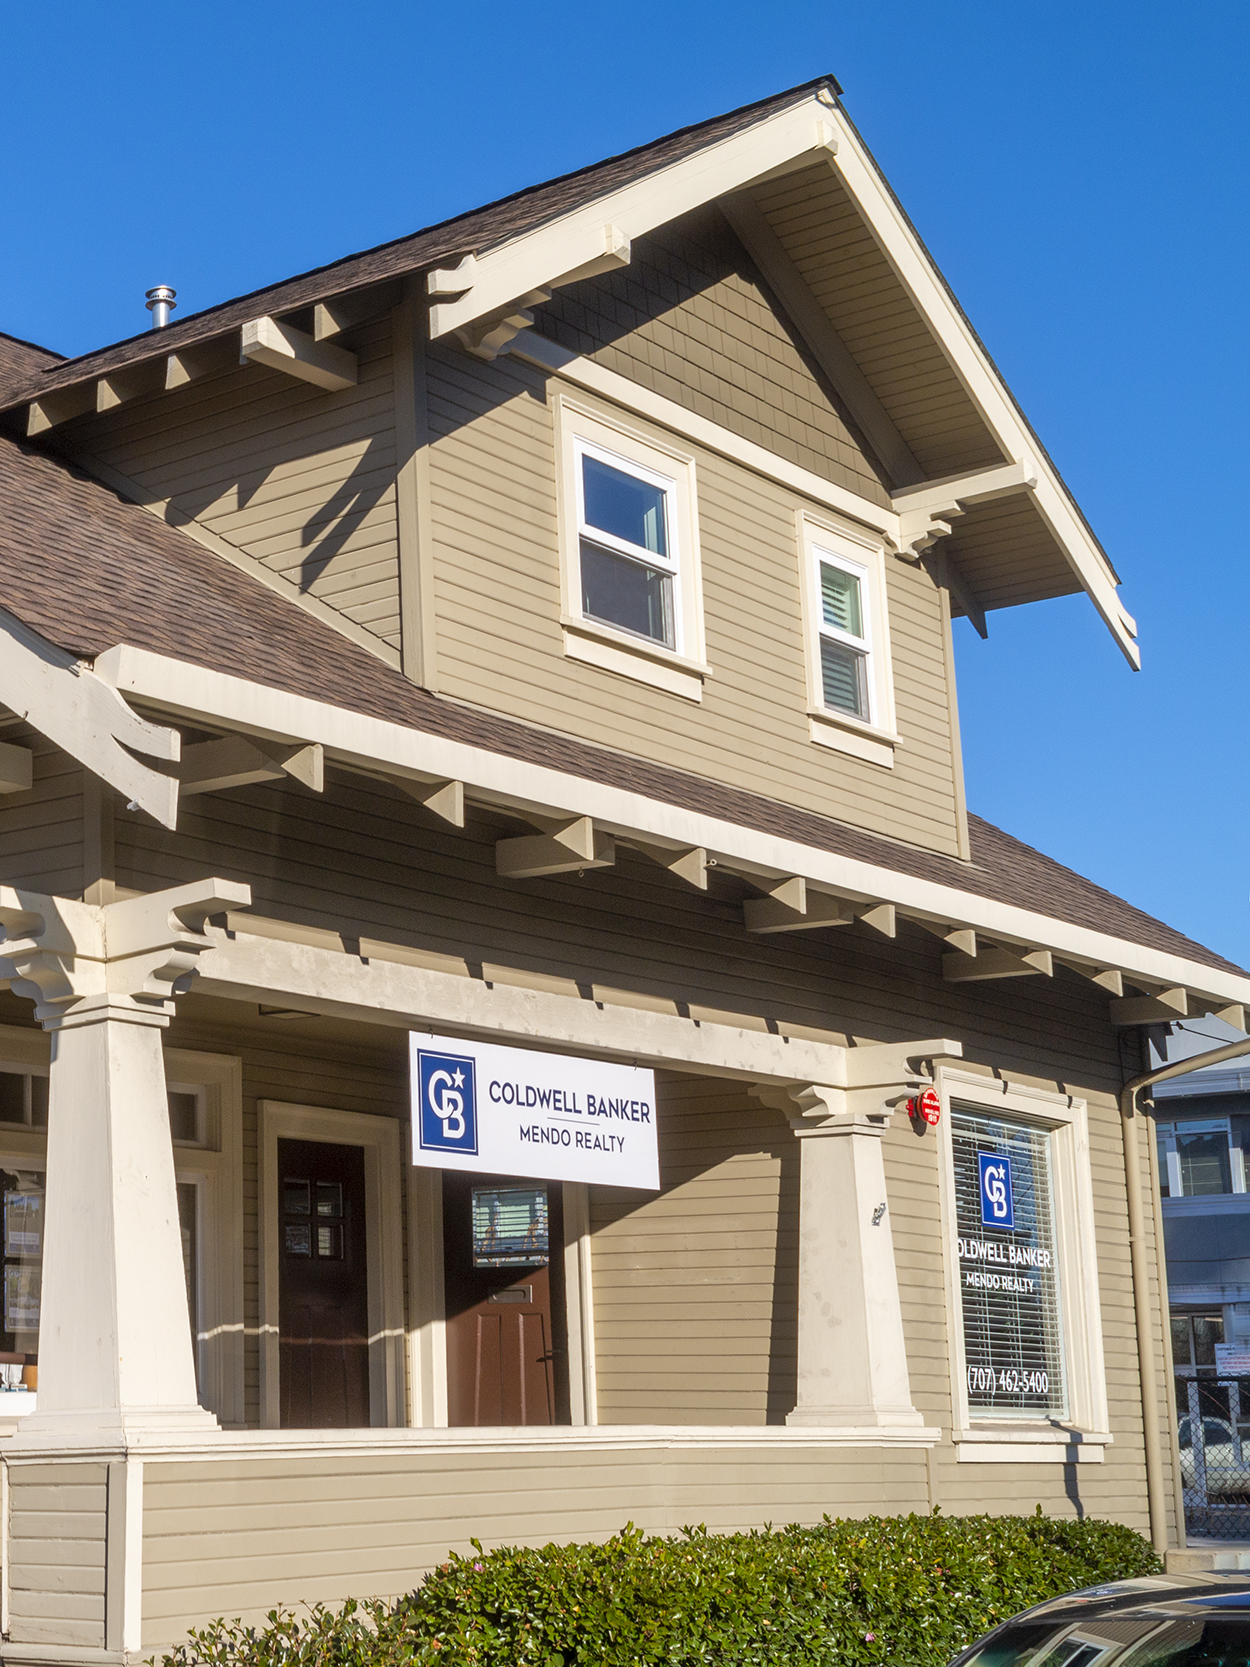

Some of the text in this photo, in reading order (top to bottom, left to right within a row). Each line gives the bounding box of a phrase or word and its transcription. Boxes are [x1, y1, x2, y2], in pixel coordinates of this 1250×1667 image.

[489, 1080, 651, 1124] COLDWELL BANKER
[519, 1124, 625, 1153] MENDO REALTY
[957, 1239, 1051, 1268] OLDWELL BANKER
[966, 1272, 1034, 1293] MENDO REALTY
[967, 1365, 1048, 1396] (707) 462-5400
